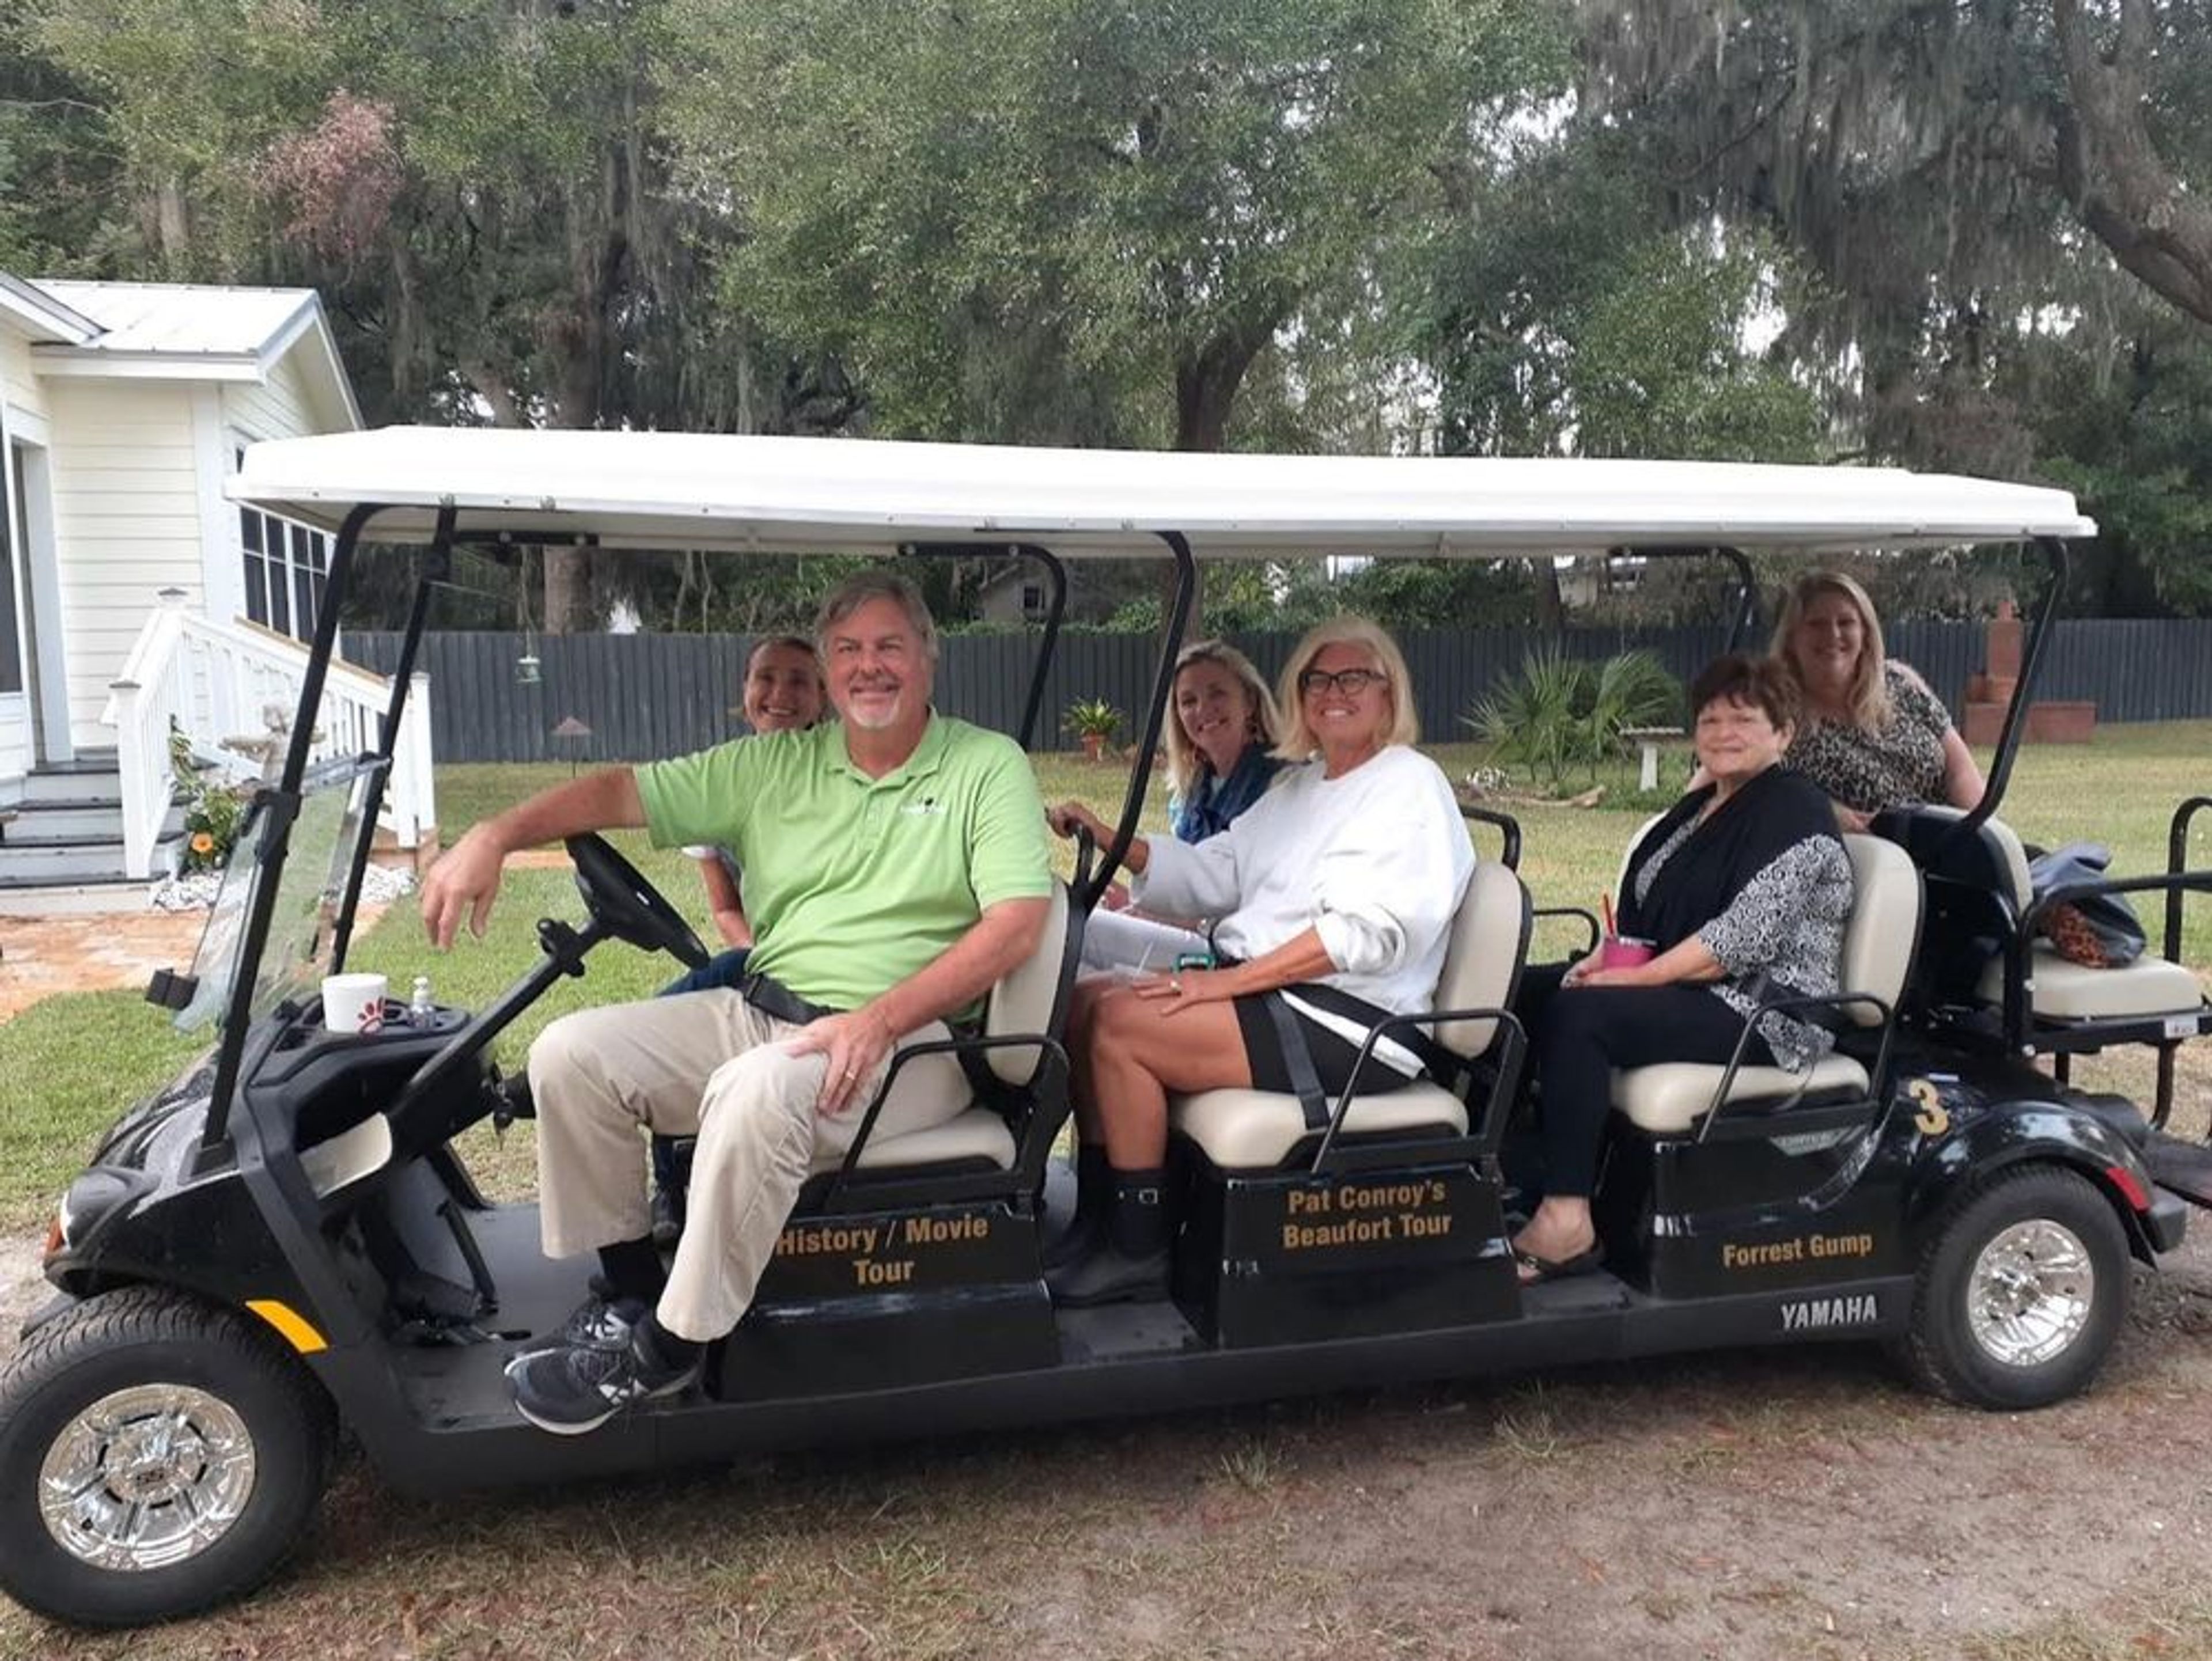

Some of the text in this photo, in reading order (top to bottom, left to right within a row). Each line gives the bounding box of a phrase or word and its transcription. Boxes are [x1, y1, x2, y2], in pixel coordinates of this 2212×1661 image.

[1909, 1079, 1948, 1135] 3
[1288, 1181, 1445, 1213] Pat Conroy's
[776, 1227, 877, 1255] History
[905, 1213, 988, 1244] Movie
[1283, 1213, 1452, 1249] Beaufort Tour
[1722, 1233, 1873, 1268] Forrest Gump
[854, 1259, 915, 1285] Tour
[1781, 1295, 1877, 1329] YAMAHA
